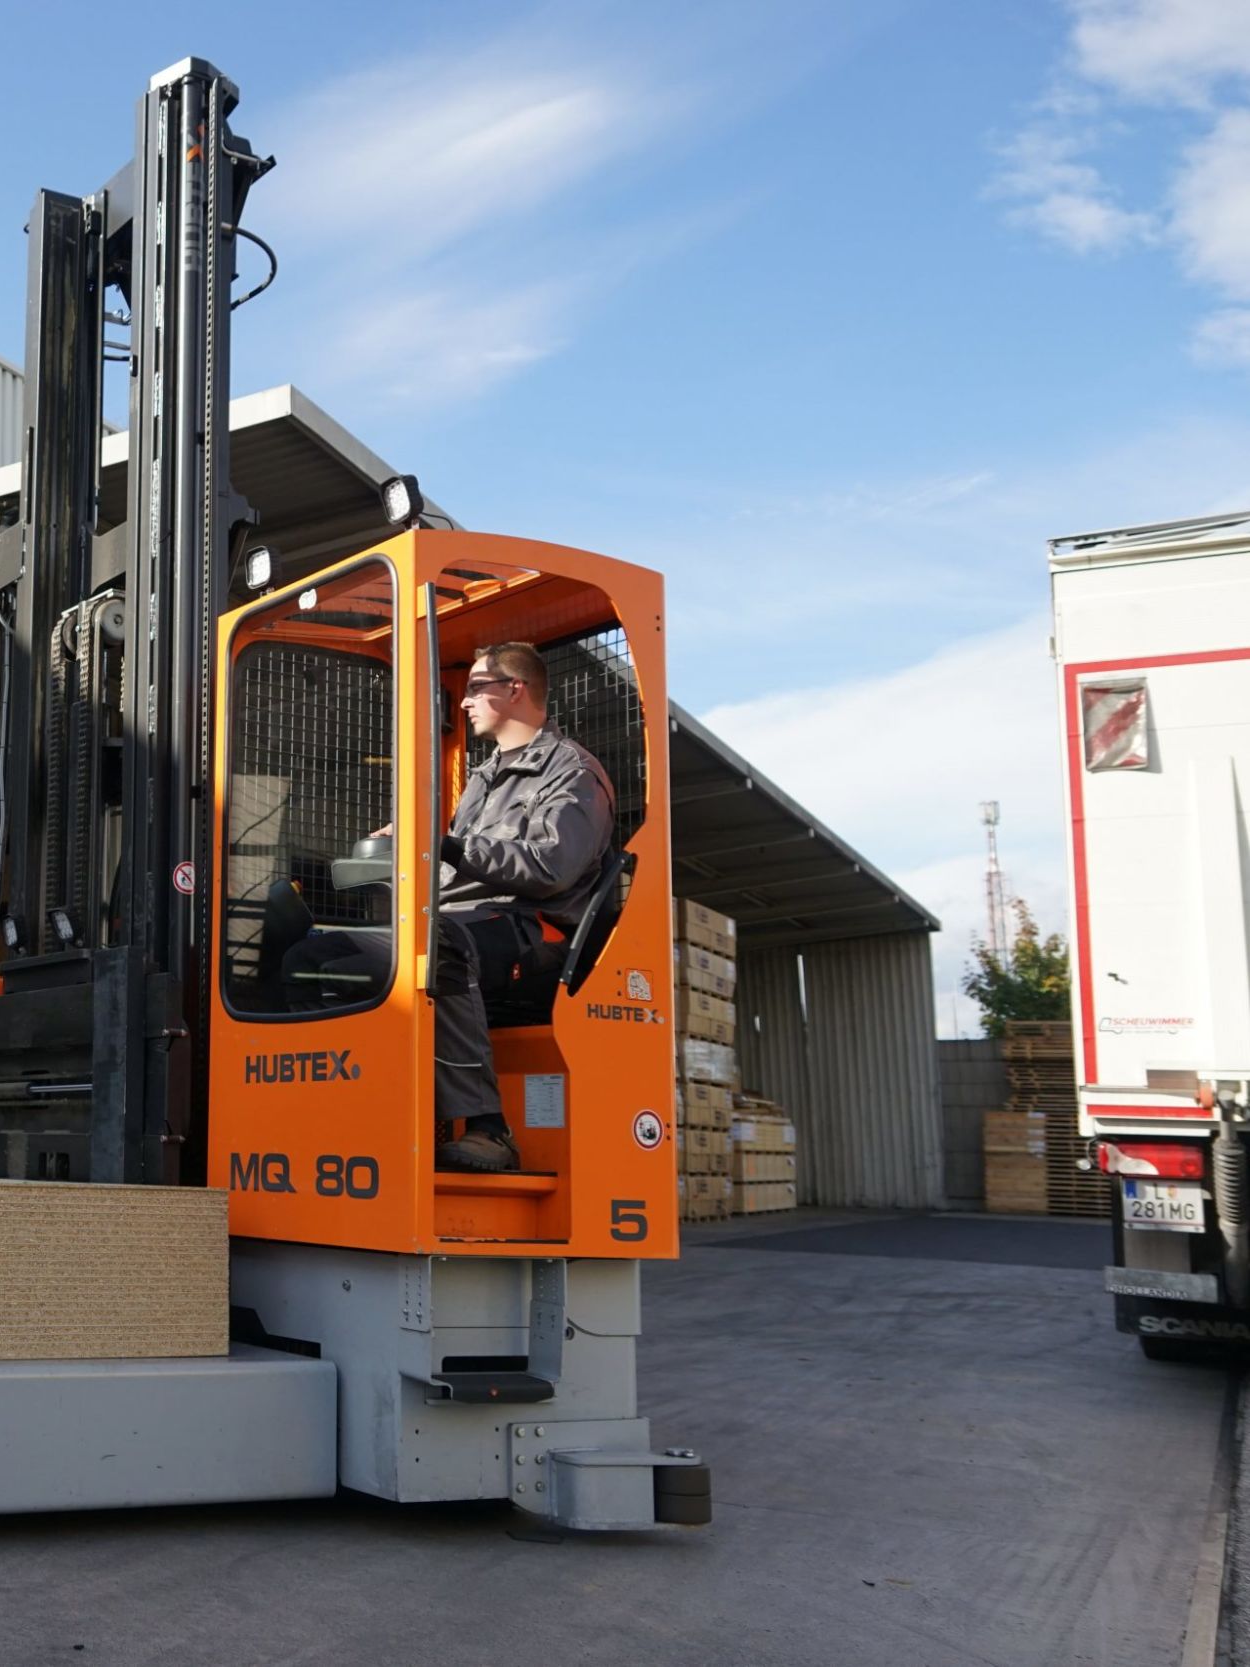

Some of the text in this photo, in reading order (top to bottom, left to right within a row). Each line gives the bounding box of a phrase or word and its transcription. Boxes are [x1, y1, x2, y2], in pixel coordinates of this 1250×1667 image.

[231, 1152, 379, 1199] MQ 80
[1153, 1182, 1164, 1200] L
[610, 1199, 648, 1242] 5
[1138, 1315, 1250, 1340] SCANIA
